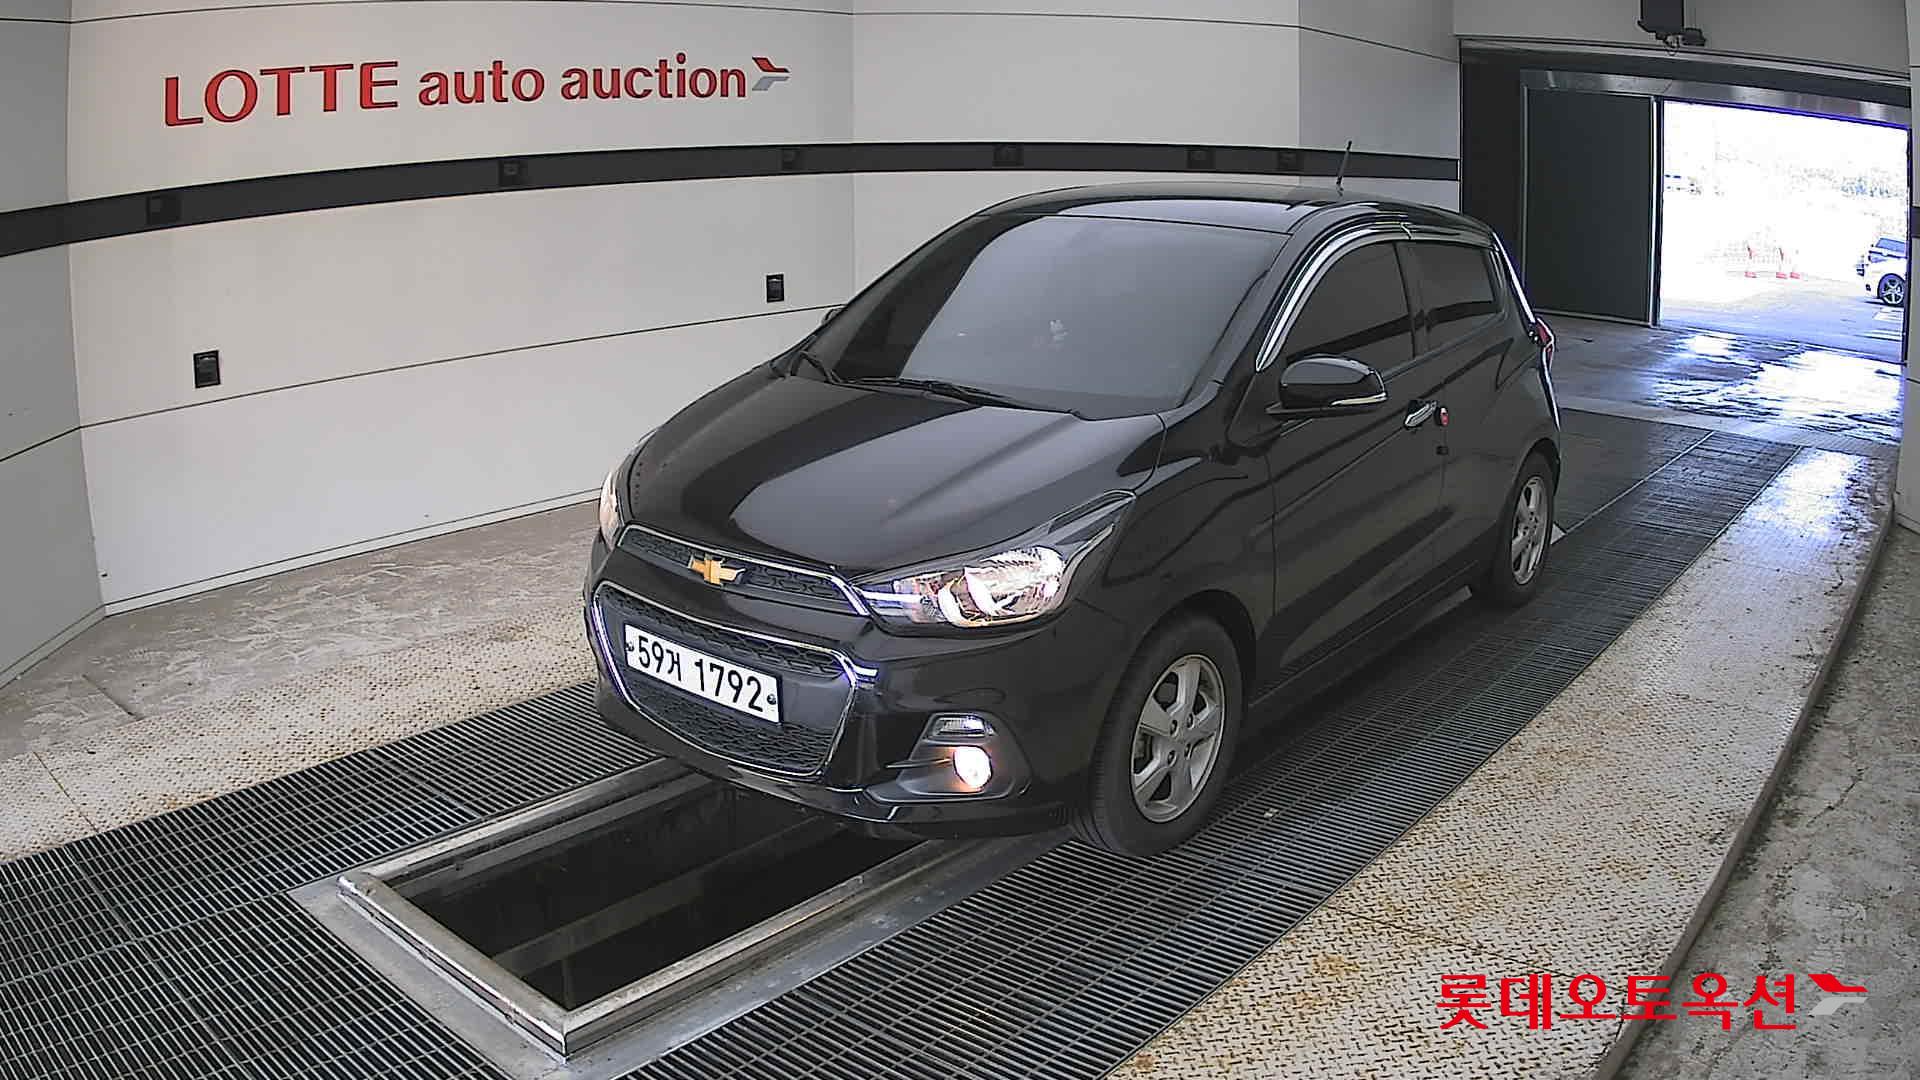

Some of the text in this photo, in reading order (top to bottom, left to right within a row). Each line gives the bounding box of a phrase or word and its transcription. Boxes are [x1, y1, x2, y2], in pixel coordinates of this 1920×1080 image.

[165, 52, 747, 126] LOTTE auto auction
[638, 635, 763, 712] 59거 1792
